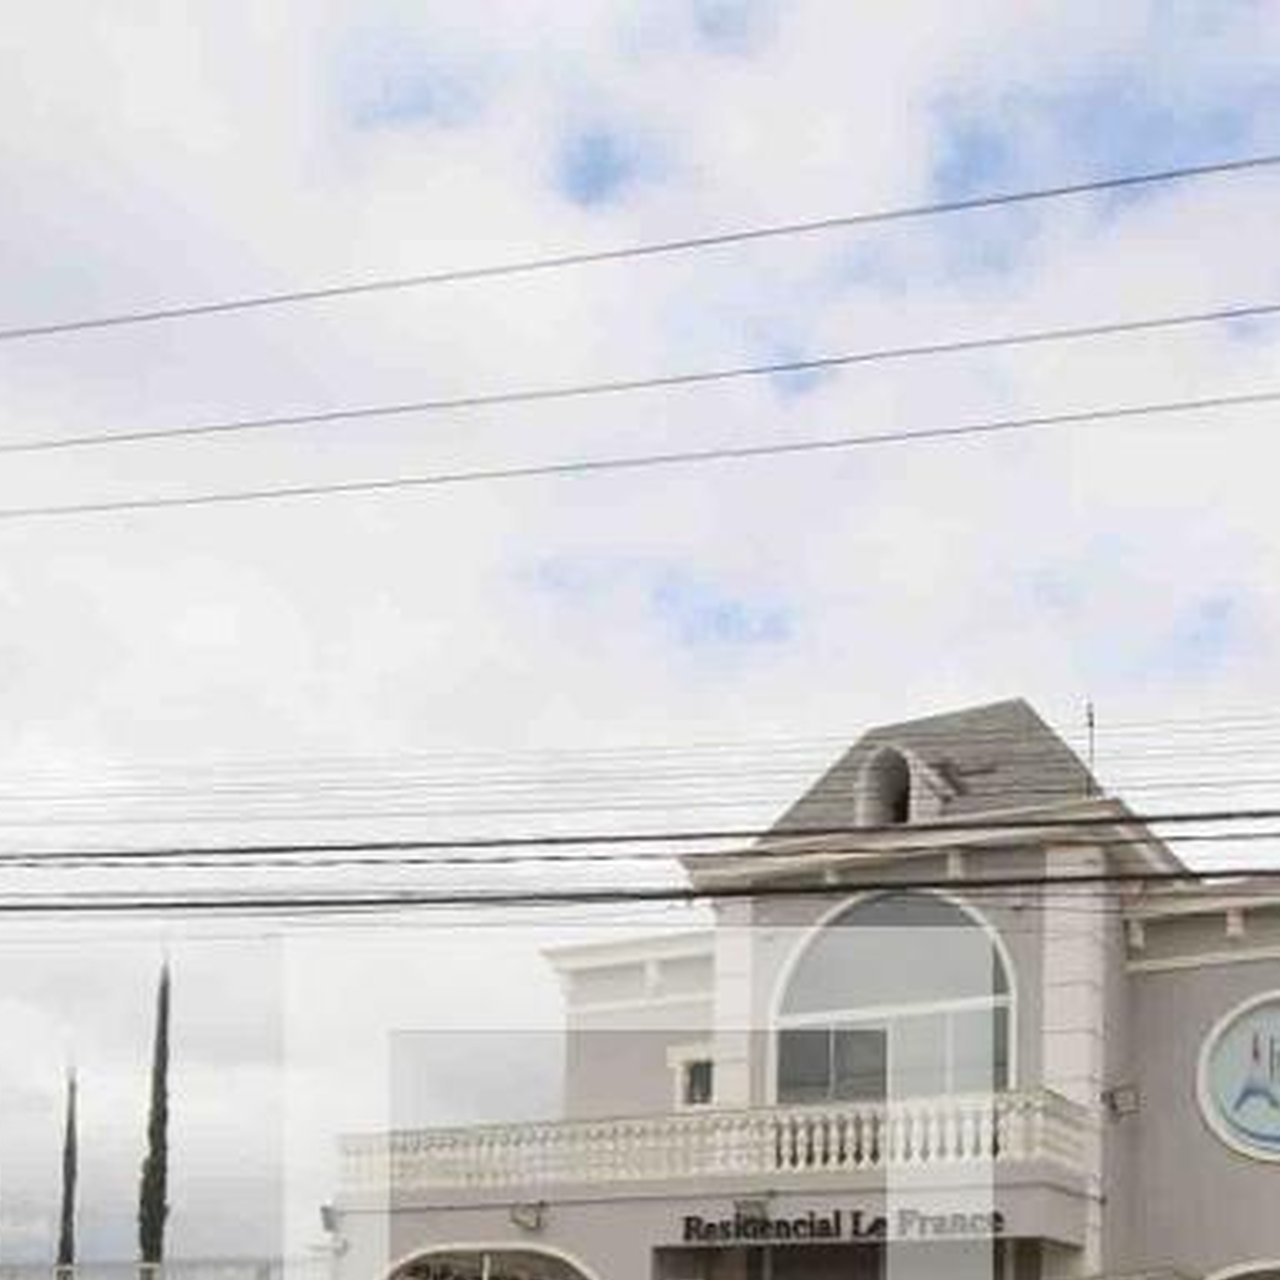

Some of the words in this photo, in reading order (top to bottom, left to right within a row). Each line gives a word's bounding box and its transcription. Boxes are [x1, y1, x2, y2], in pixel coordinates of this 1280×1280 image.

[682, 1208, 841, 1242] Residencial
[850, 1209, 887, 1238] Le
[896, 1209, 1006, 1237] France
